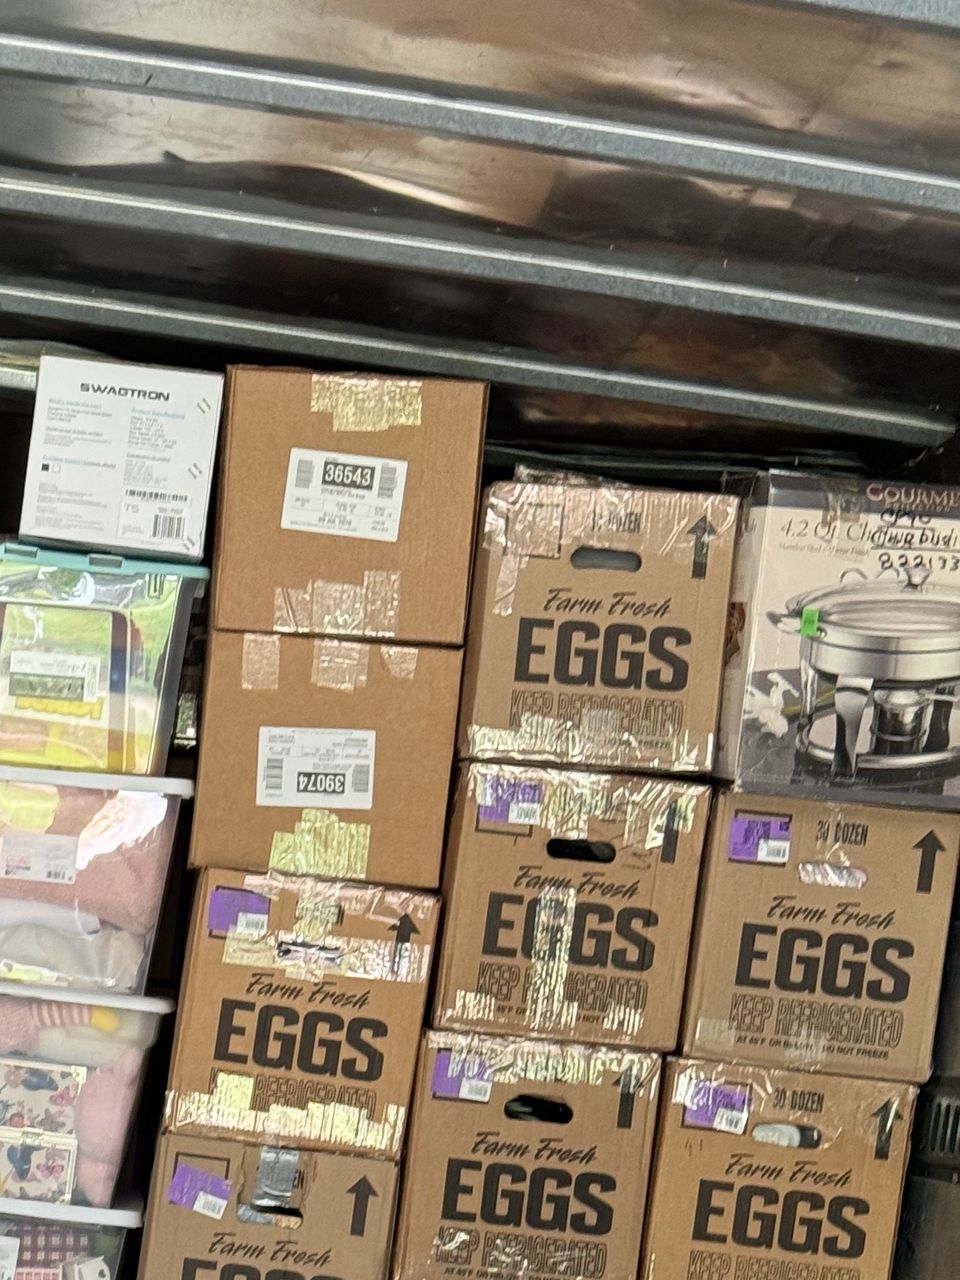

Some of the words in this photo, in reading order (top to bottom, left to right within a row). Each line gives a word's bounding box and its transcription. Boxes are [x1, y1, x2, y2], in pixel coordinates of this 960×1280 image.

[79, 382, 170, 401] SWAGTRON
[325, 465, 371, 485] 36543
[544, 588, 602, 614] Farm
[608, 591, 673, 618] Fresh
[513, 617, 692, 692] EGGS
[298, 774, 344, 792] 39074
[834, 824, 869, 847] DOZEN
[514, 865, 572, 890] Farm
[575, 872, 640, 899] Fresh
[766, 895, 827, 922] Farm
[831, 901, 896, 929] Fresh
[734, 922, 914, 1004] EGGS
[245, 972, 305, 1001] Farm
[307, 980, 370, 1009] Fresh
[728, 991, 775, 1034] KEEP
[775, 996, 904, 1048] REFRIGERATED
[213, 997, 389, 1082] EGGS
[772, 1087, 787, 1110] 30
[791, 1089, 825, 1114] DOZEN
[472, 1131, 530, 1154] Farm
[535, 1138, 598, 1165] Fresh
[725, 1152, 784, 1182] Farm
[788, 1160, 852, 1188] Fresh
[441, 1157, 617, 1236] EGGS
[692, 1178, 870, 1259] EGGS
[207, 1231, 266, 1257] Farm
[270, 1239, 332, 1268] Fresh
